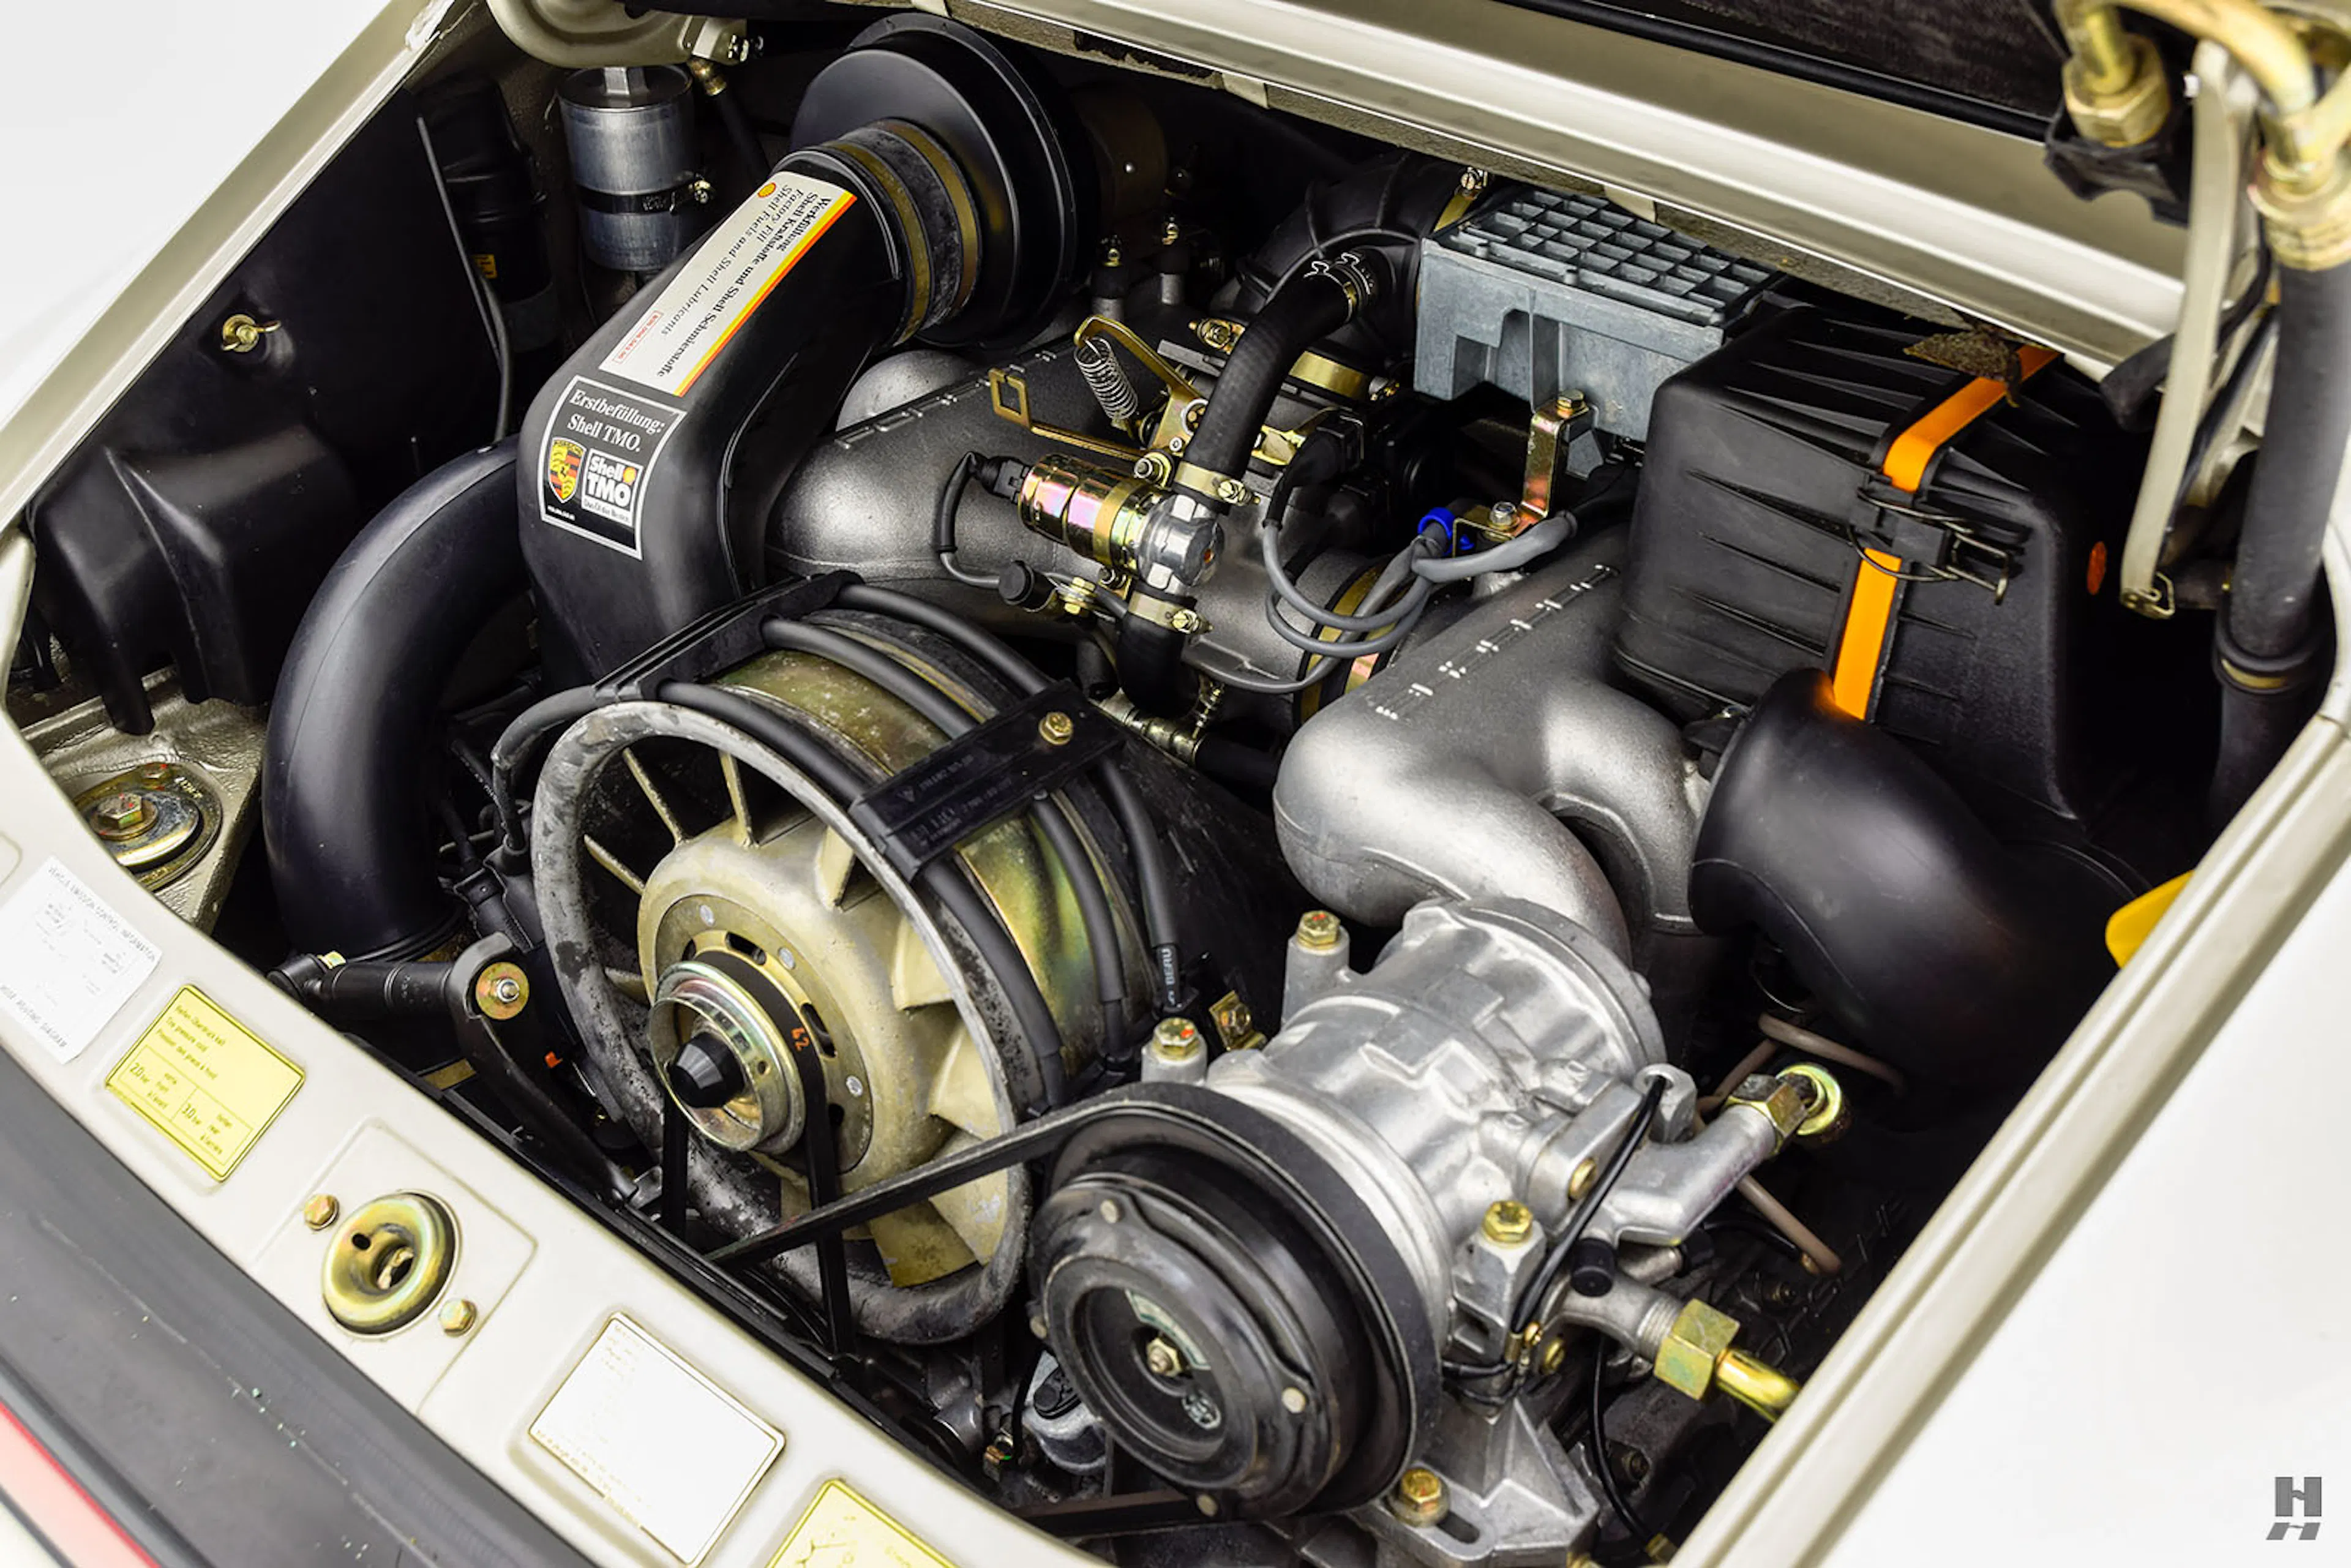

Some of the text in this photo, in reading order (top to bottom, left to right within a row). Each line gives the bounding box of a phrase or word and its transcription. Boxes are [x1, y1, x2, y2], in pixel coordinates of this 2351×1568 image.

[757, 189, 804, 242] Factory Fill
[793, 192, 818, 217] Shell
[661, 185, 792, 336] Shell Fuels and Shell Lubricants
[735, 266, 754, 285] und
[713, 286, 739, 312] Shell
[657, 313, 716, 377] Schmierstoffe
[569, 389, 666, 435] Erstbefüllung:
[568, 413, 602, 440] Shell
[602, 424, 641, 452] TMO.
[590, 455, 625, 481] Shell
[588, 472, 631, 508] TMO
